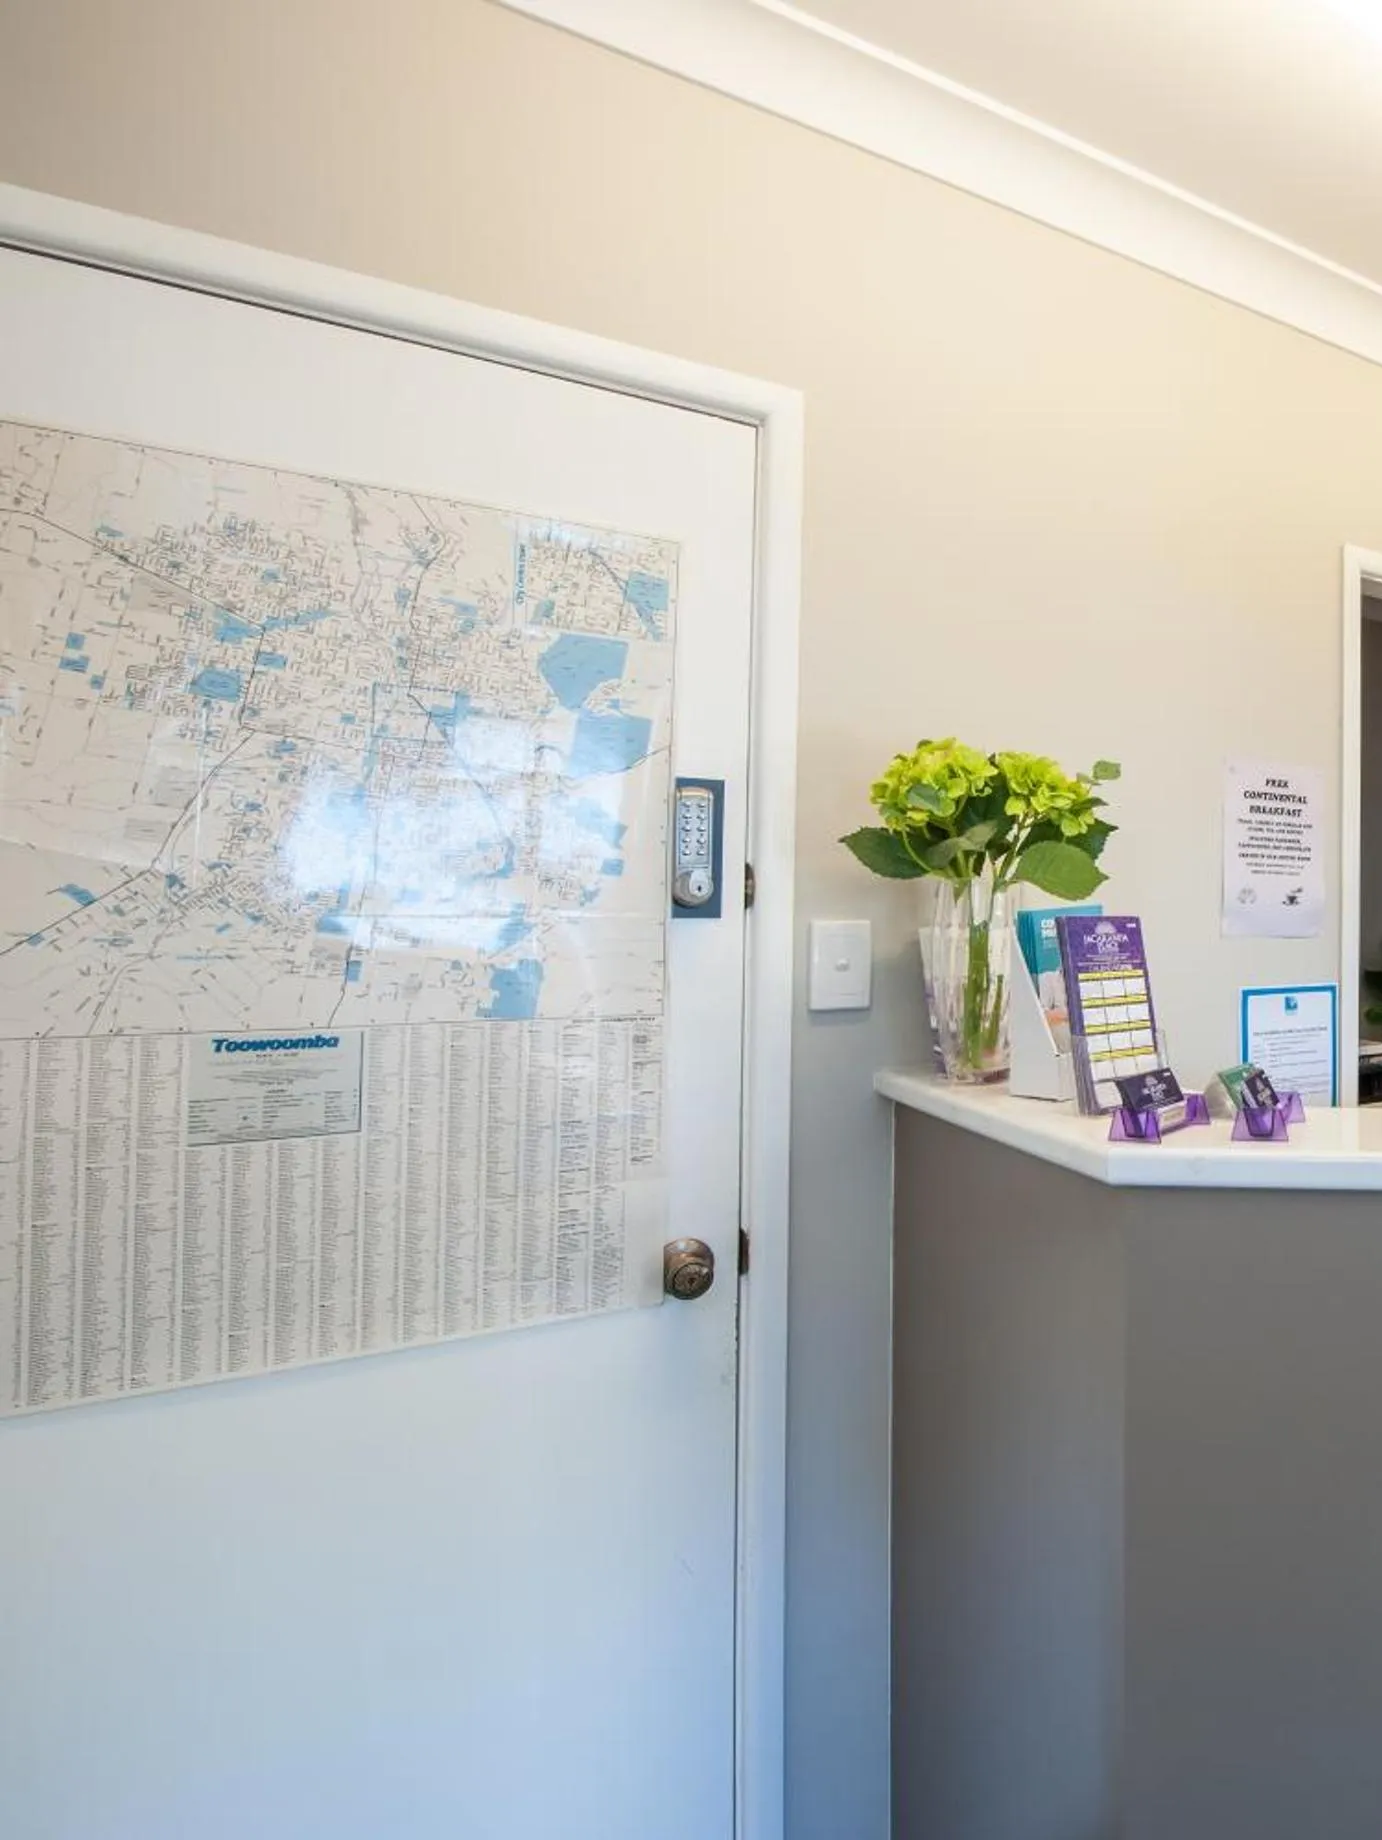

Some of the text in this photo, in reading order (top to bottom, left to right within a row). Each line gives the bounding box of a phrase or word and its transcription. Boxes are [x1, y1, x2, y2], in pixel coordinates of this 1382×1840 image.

[1265, 778, 1289, 788] FREE
[1243, 791, 1308, 804] CONTINENTAL
[1249, 805, 1303, 817] BREAKFAST
[212, 1034, 340, 1053] Toowoomba
